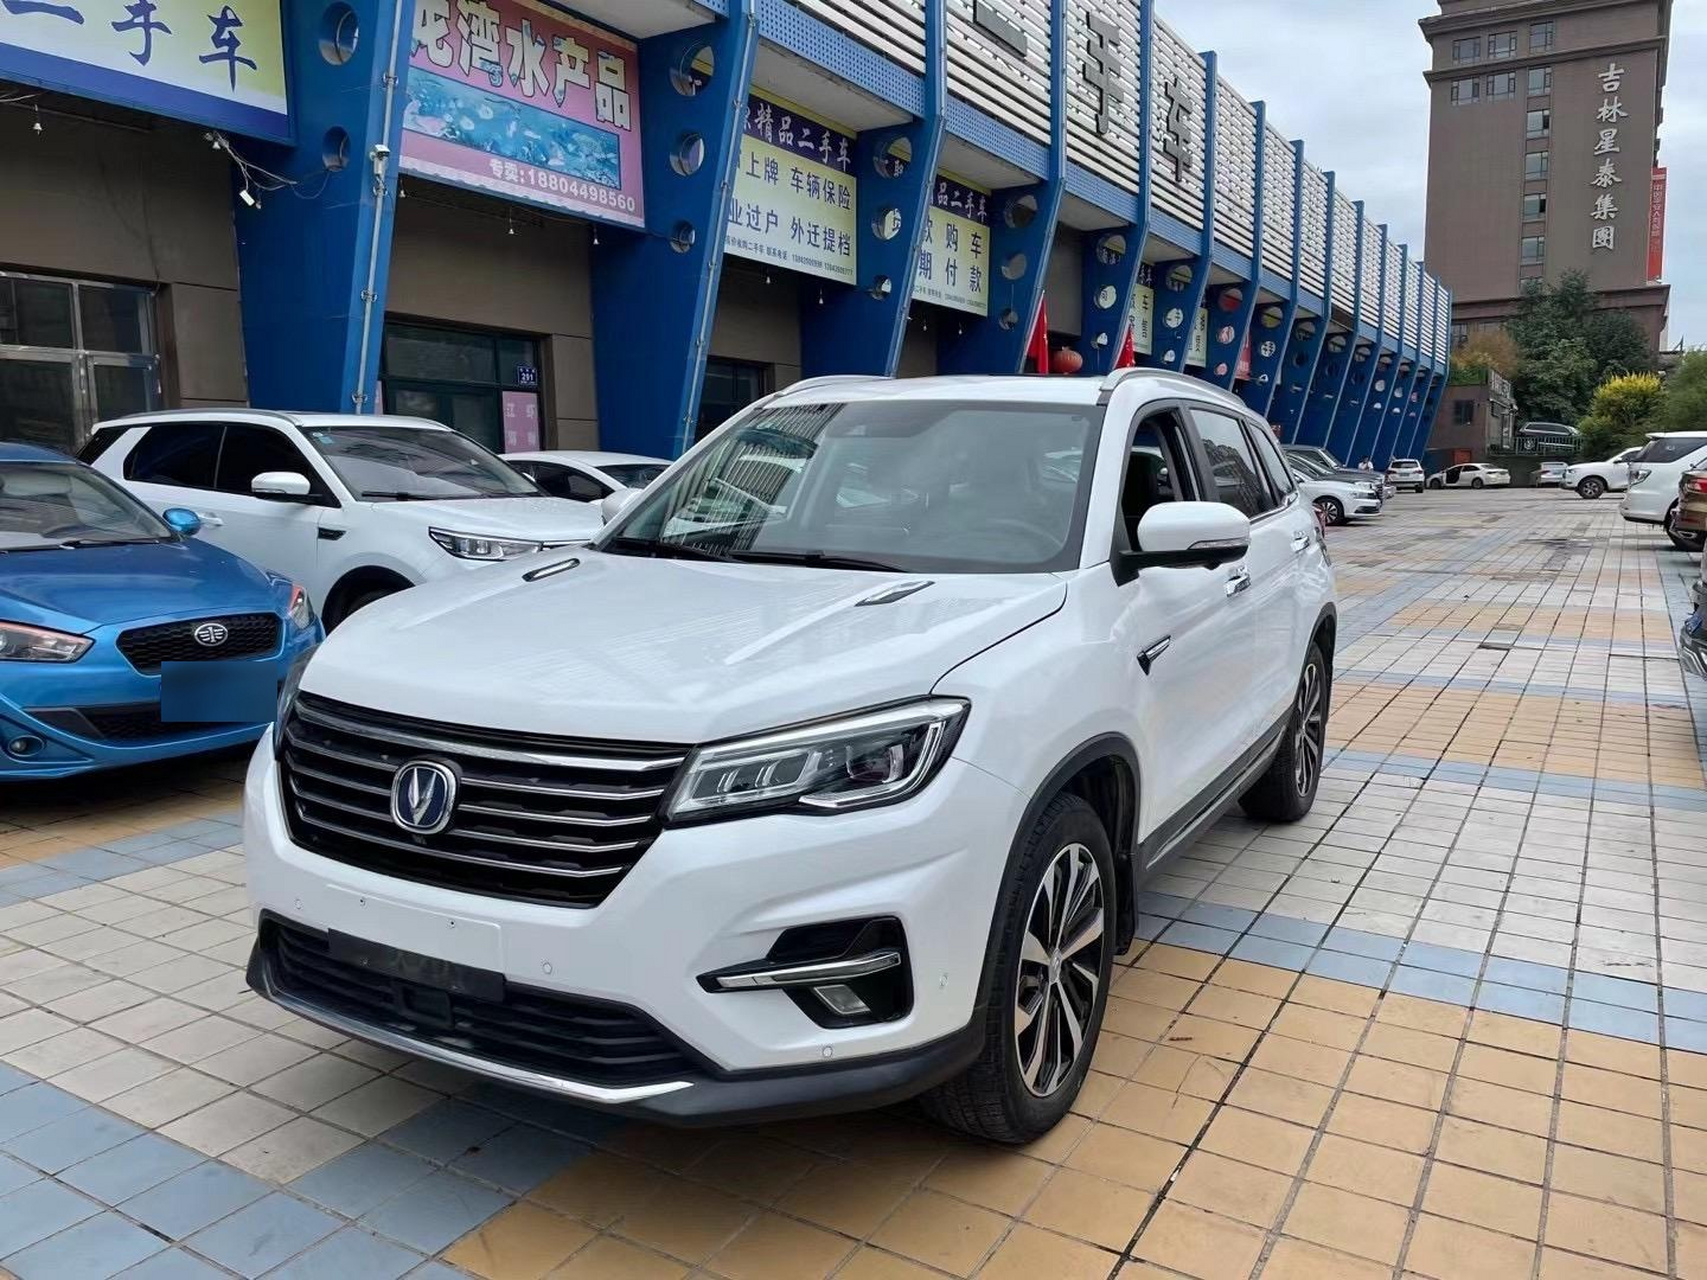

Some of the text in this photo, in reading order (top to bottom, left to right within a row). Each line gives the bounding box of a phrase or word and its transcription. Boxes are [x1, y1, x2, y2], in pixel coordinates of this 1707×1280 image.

[737, 149, 779, 185] 上牌
[791, 166, 851, 211] 车辆保险
[930, 182, 987, 222] 品二手车
[728, 198, 778, 234] 业过户
[791, 217, 851, 257] 外迁提档
